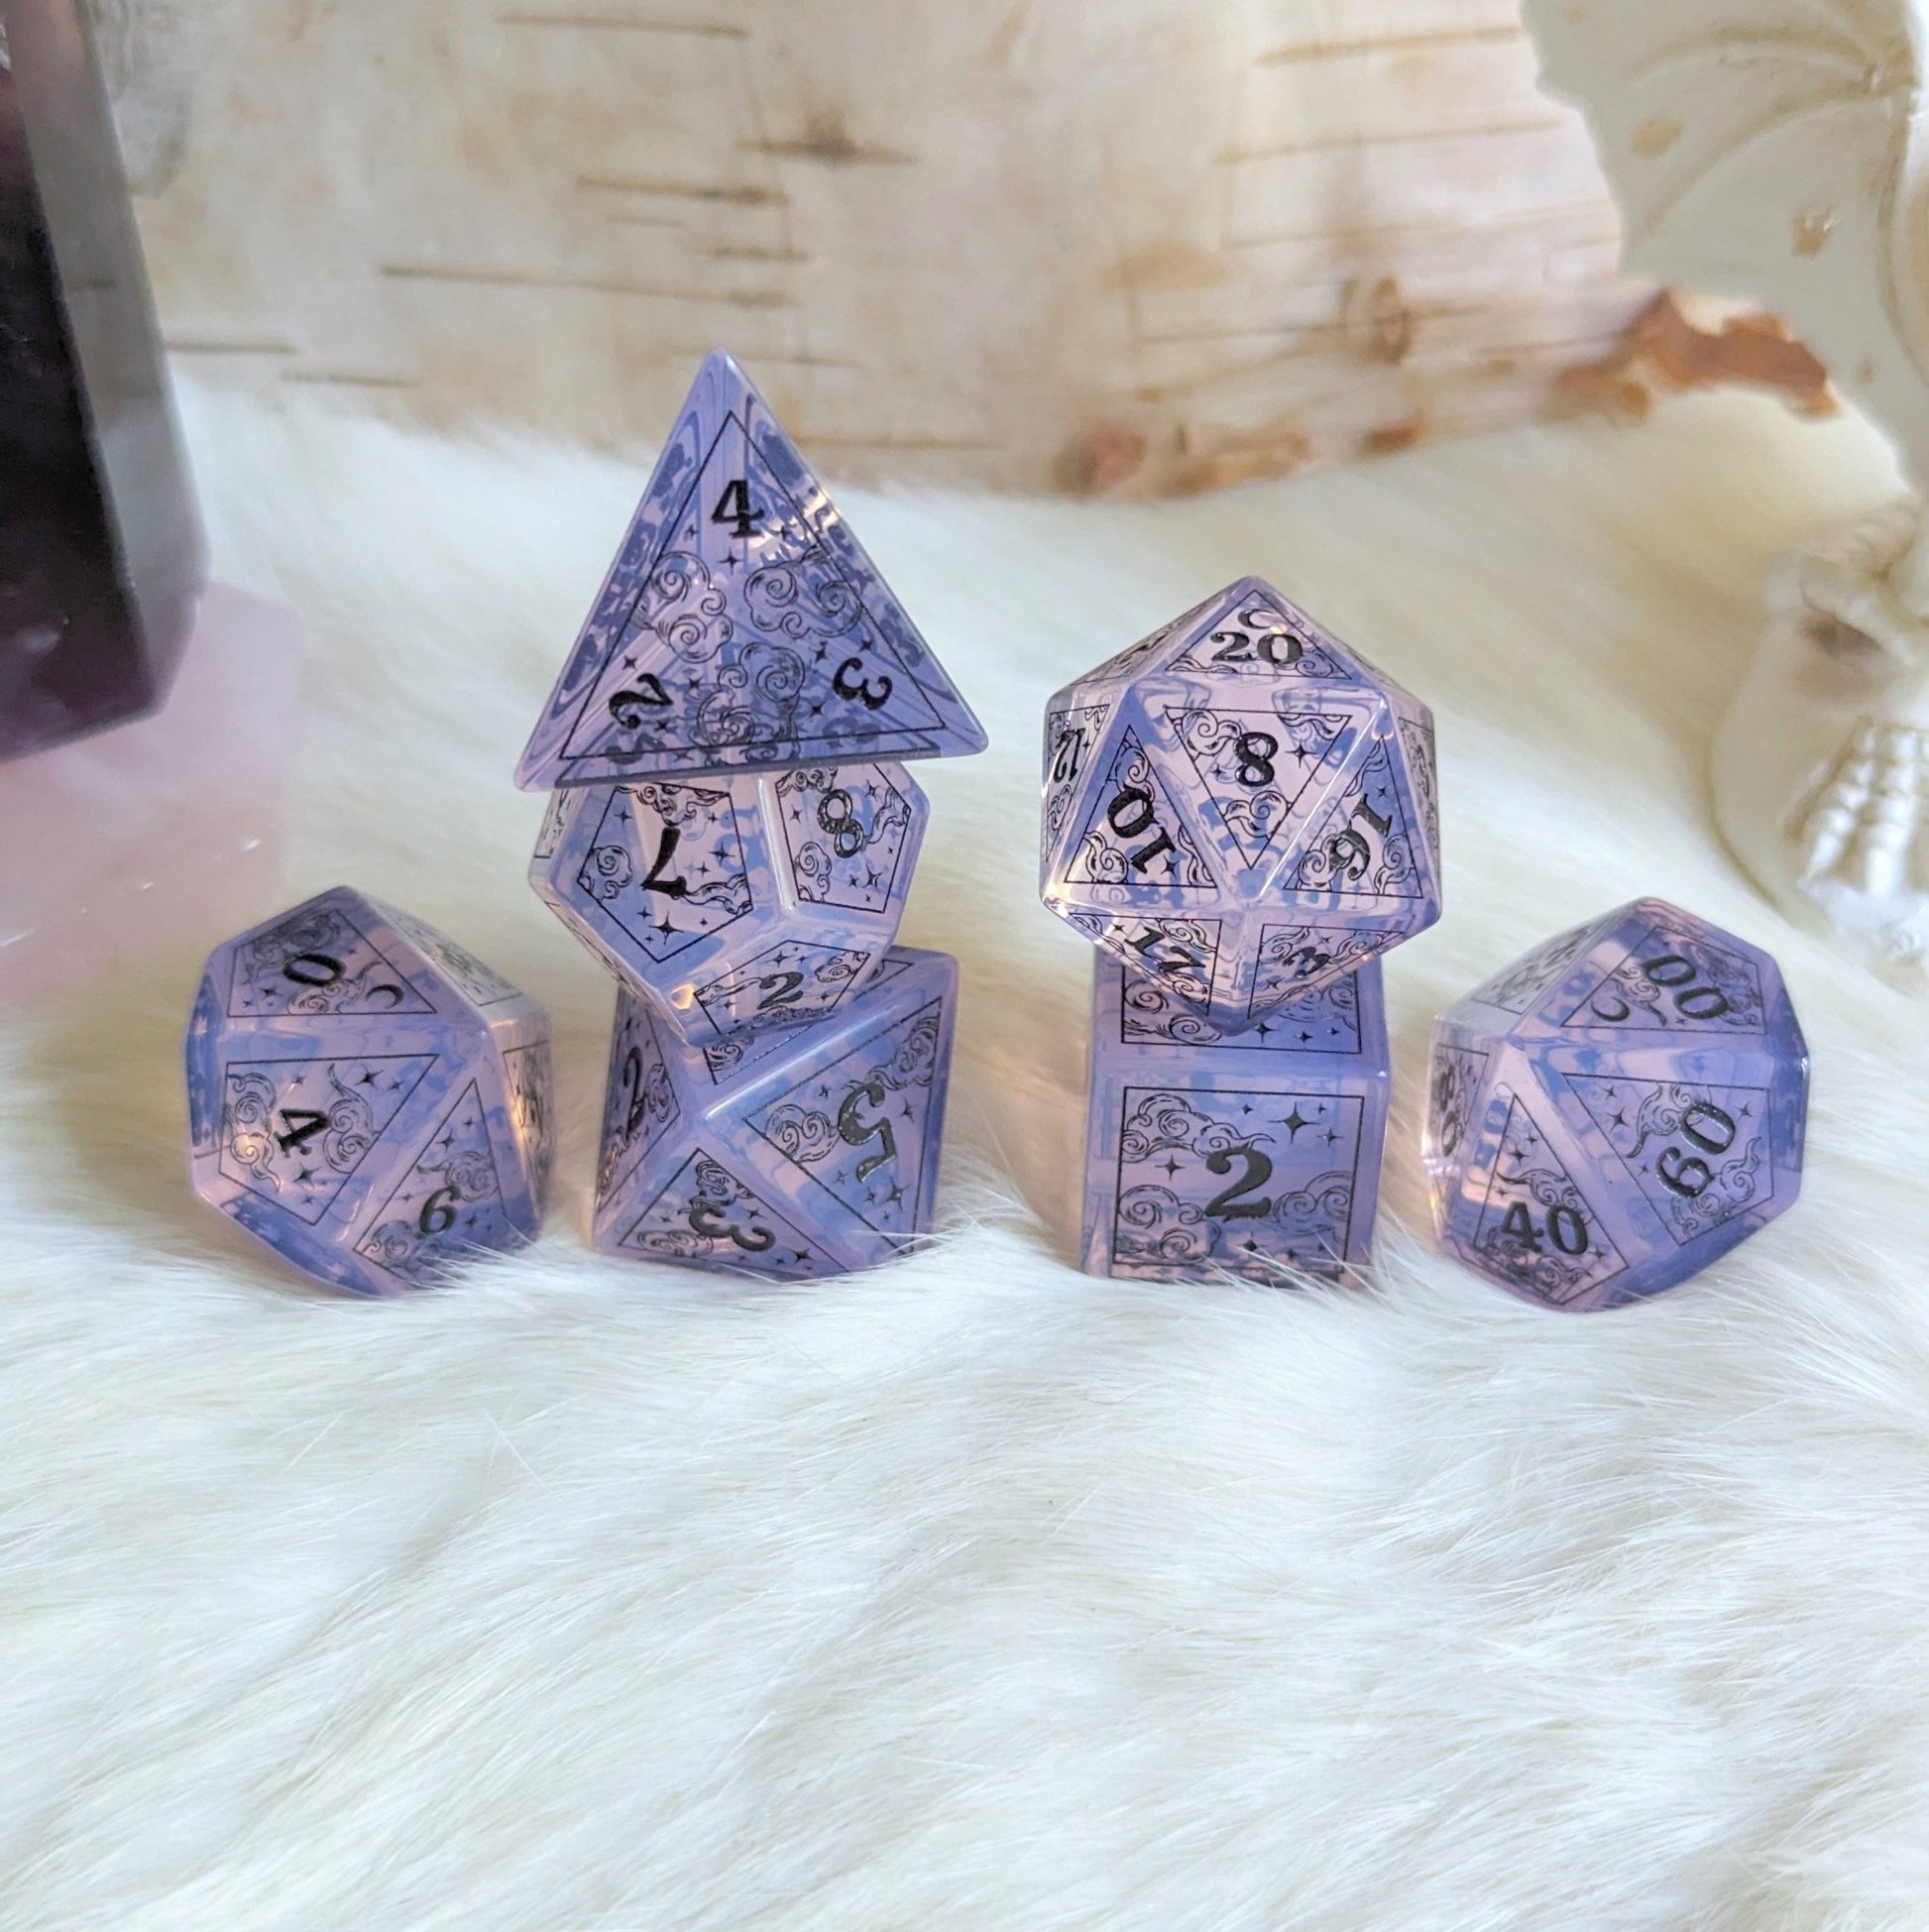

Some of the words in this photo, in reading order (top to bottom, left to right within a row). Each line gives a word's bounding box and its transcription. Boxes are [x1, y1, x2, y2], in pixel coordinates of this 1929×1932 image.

[712, 480, 764, 538] 4
[1210, 631, 1303, 665] 20
[609, 672, 673, 729] 2
[833, 657, 892, 710] 3
[1233, 732, 1280, 787] 8
[818, 788, 863, 858] 8
[1107, 787, 1177, 874] 10
[1328, 793, 1393, 881] 16
[642, 827, 687, 899] 7
[283, 953, 348, 987] 0
[757, 970, 806, 1011] 2
[1643, 954, 1730, 1020] 00
[273, 1107, 332, 1159] 4
[838, 1081, 899, 1184] 5
[1655, 1100, 1737, 1198] 60
[1204, 1146, 1273, 1220] 2
[688, 1199, 776, 1252] 3
[1500, 1200, 1590, 1256] 40
